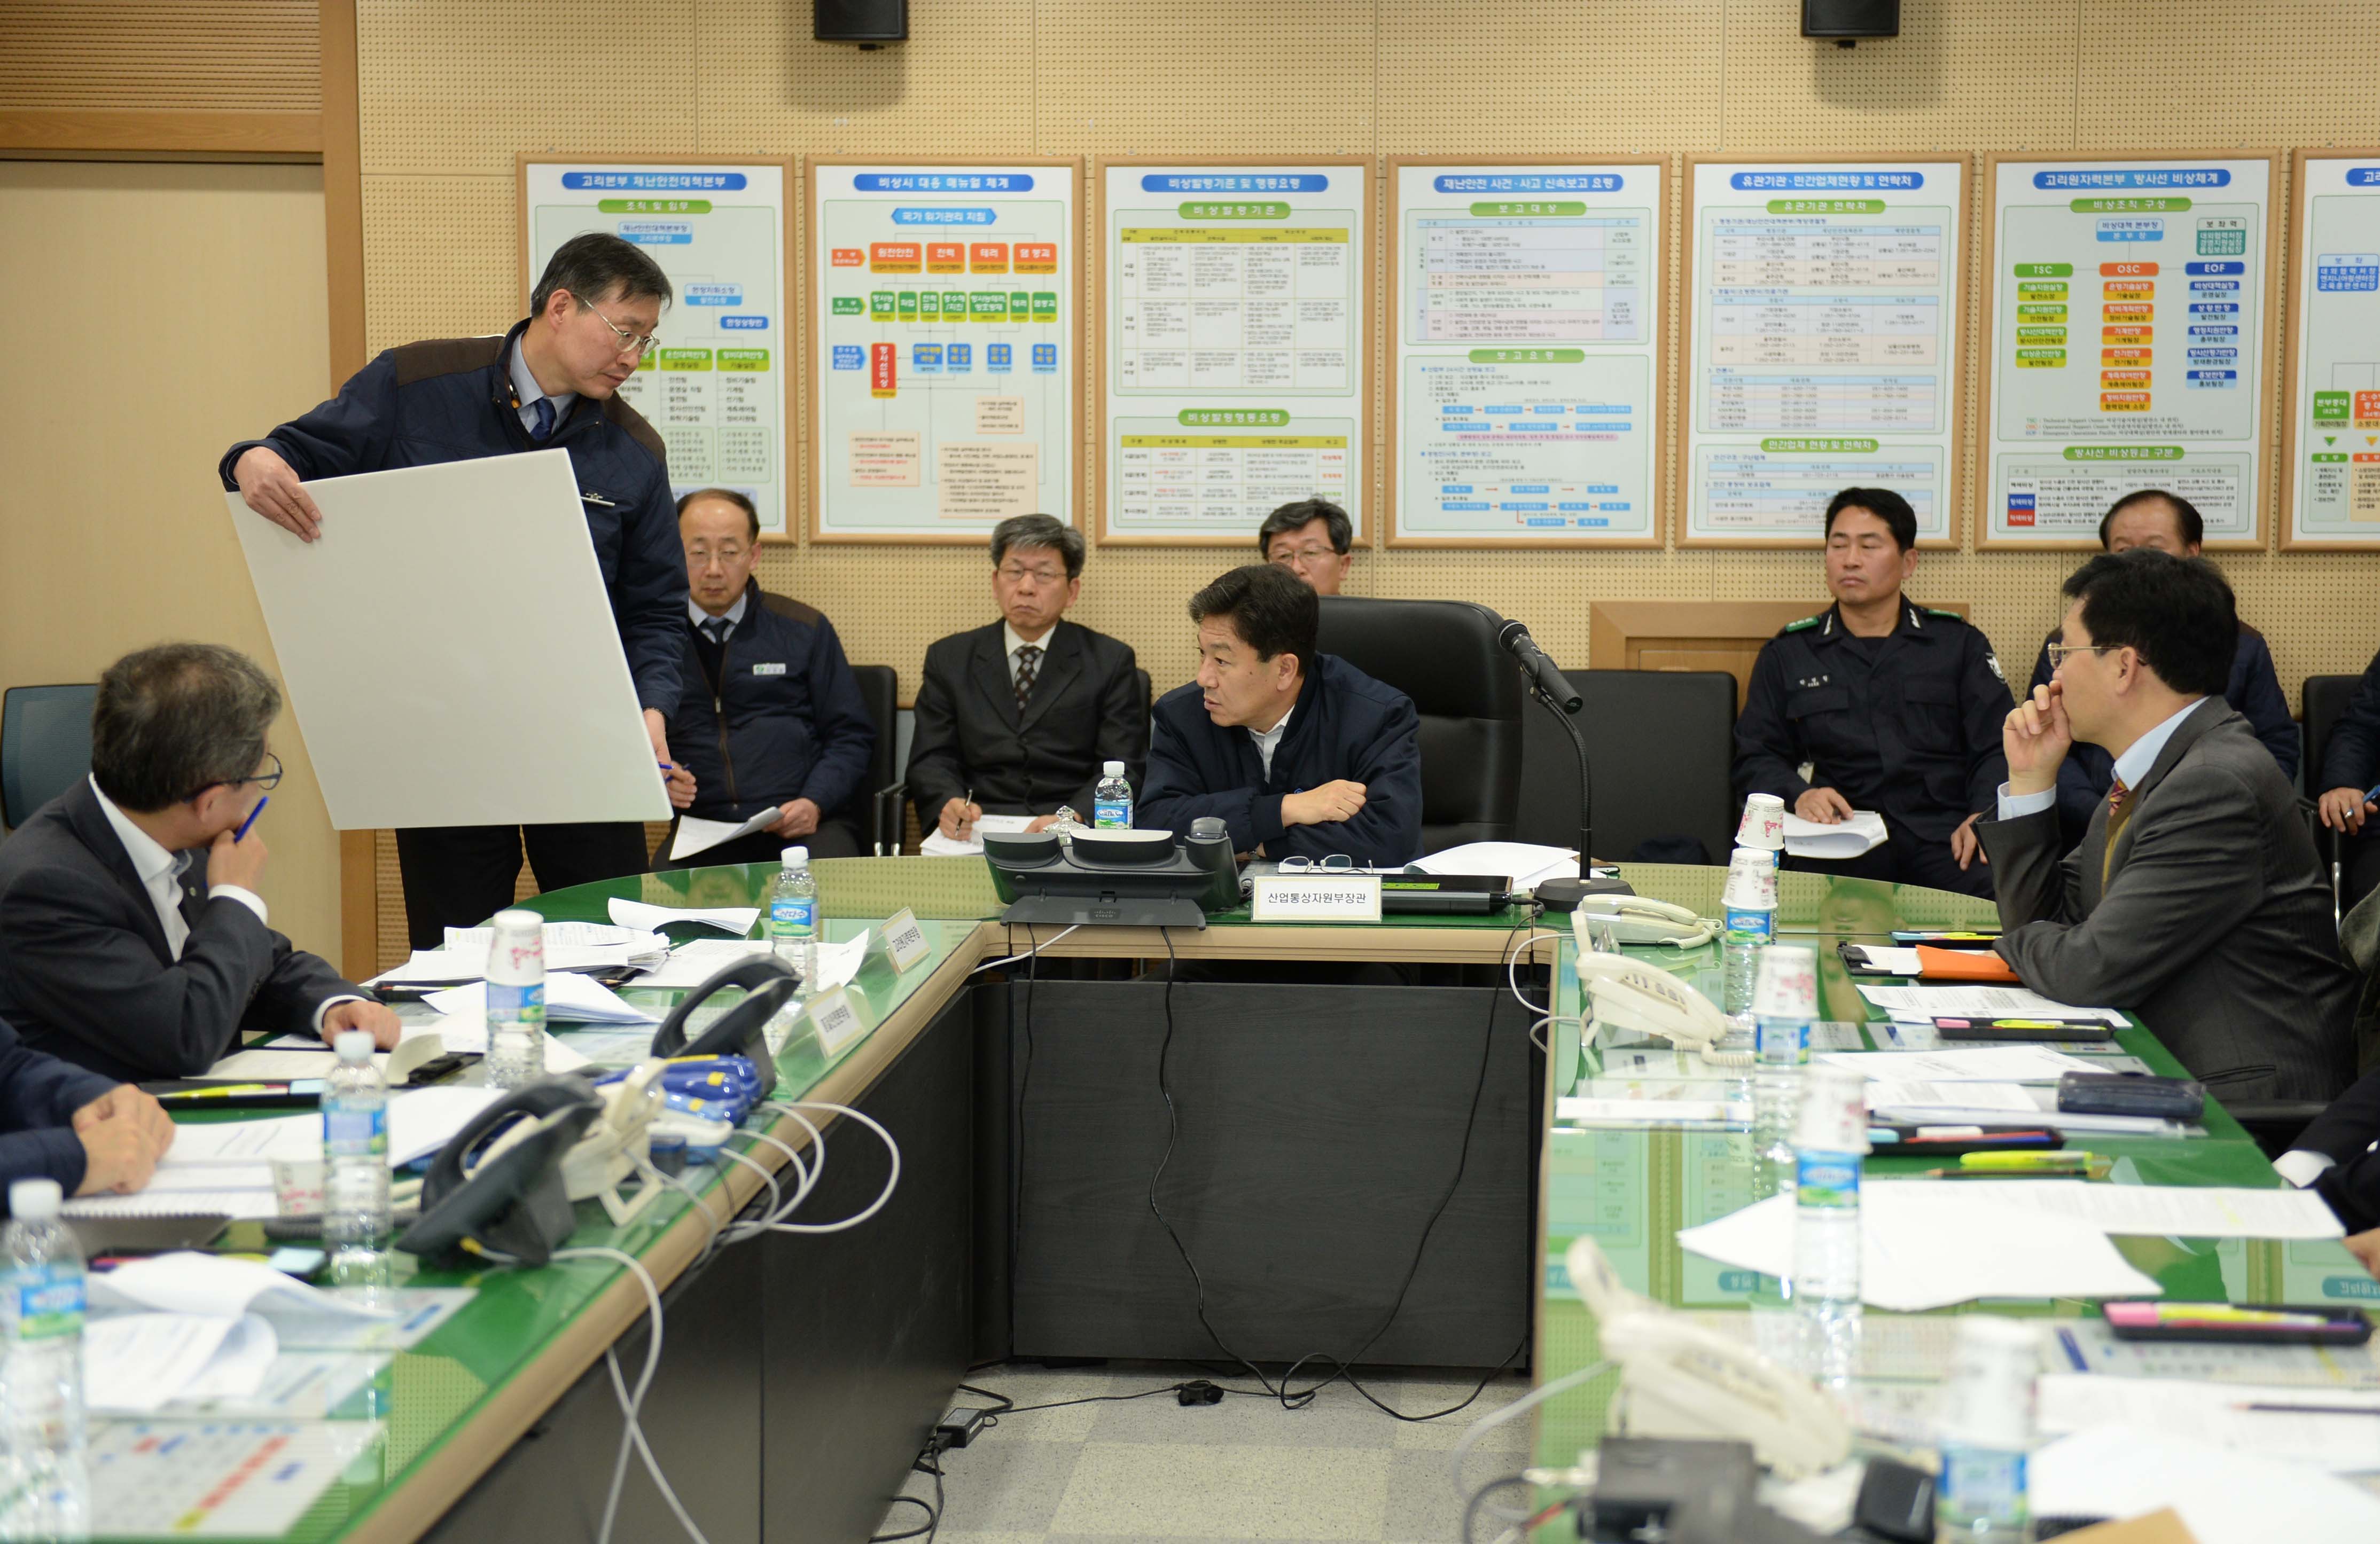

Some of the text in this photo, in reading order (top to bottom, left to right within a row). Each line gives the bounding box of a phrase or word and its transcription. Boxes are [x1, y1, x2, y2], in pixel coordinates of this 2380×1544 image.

[582, 176, 726, 187] 고리본부 재난안전대책본부
[879, 178, 1009, 189] 비상시 대응 매뉴얼 체계
[1168, 178, 1300, 189] 비상발령기준 및 행동요령
[1443, 179, 1487, 189] 재난안전
[1545, 178, 1588, 189] 신속보고
[1592, 178, 1613, 189] 요령
[1864, 176, 1874, 187] 및
[1879, 176, 1912, 187] 연락처
[2046, 174, 2218, 185] 고리원자력본부 방사선 비상체계
[653, 201, 661, 211] 및
[2094, 200, 2165, 209] 비상조직 구성
[902, 212, 986, 222] 국가 위기관리 지침
[2204, 264, 2225, 272] EOF
[2197, 304, 2230, 312] 상황반장
[2075, 448, 2173, 458] 방사선 비상등급 구분
[1268, 892, 1366, 904] 산업통상자원부장관
